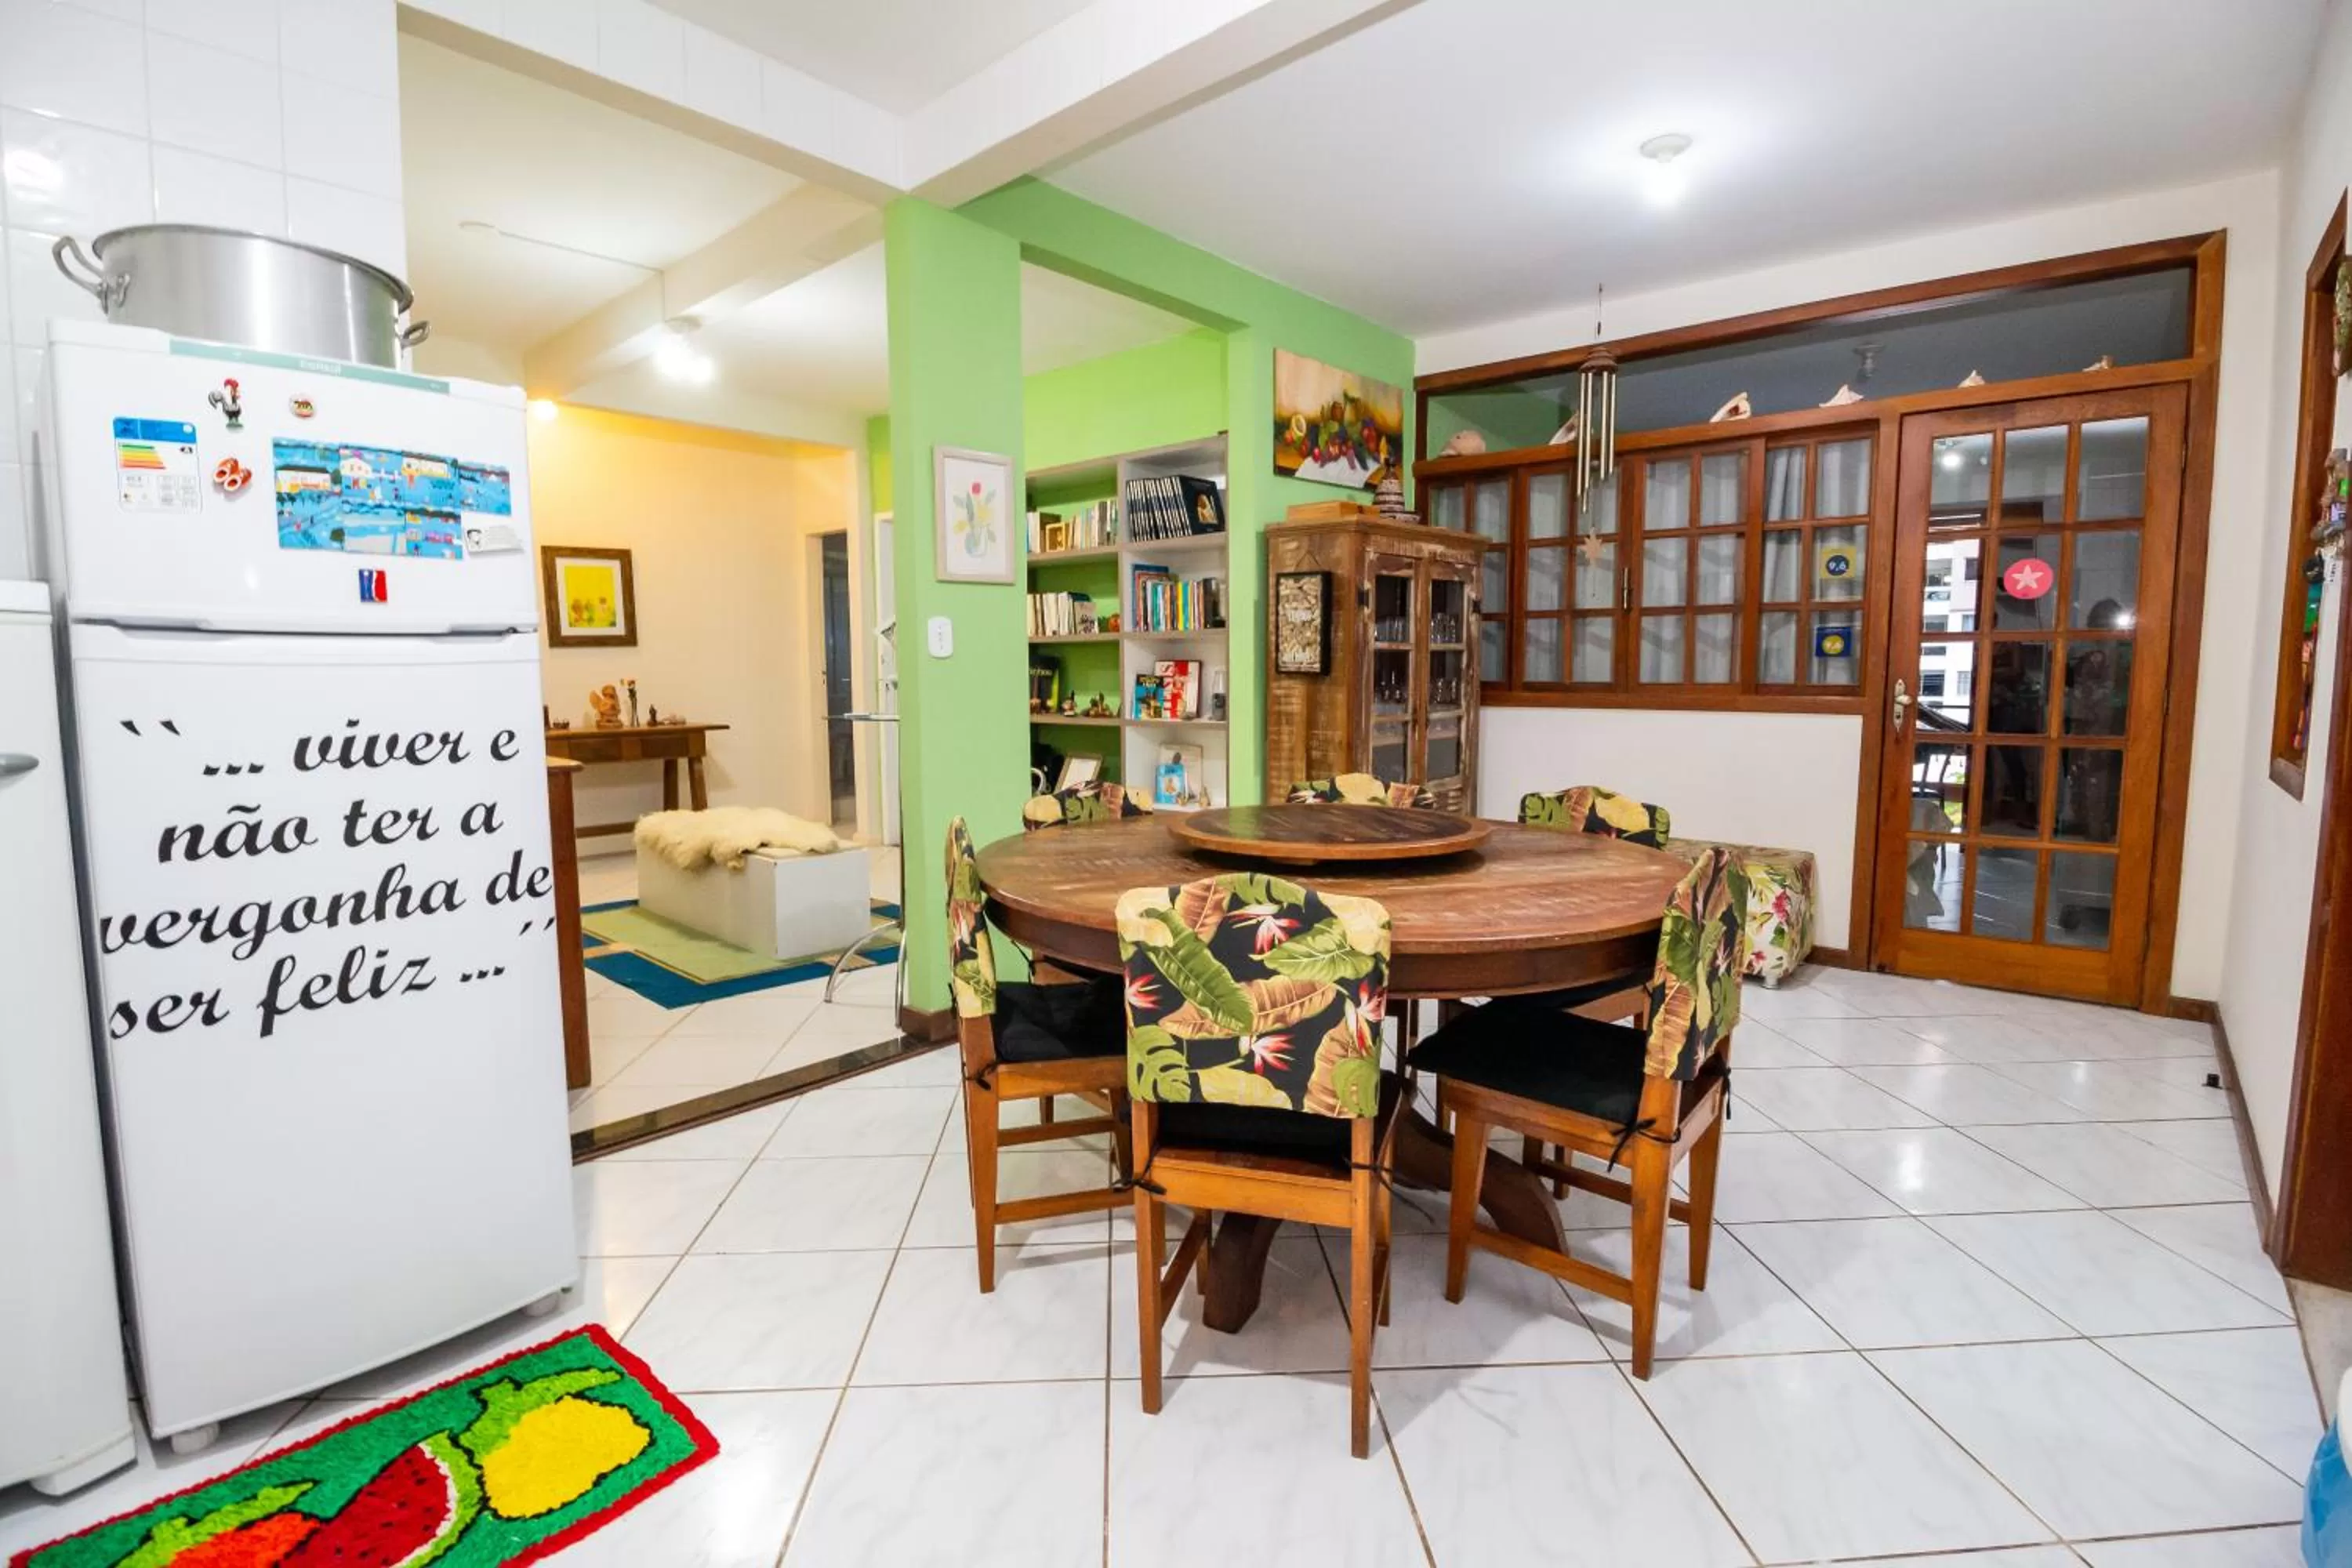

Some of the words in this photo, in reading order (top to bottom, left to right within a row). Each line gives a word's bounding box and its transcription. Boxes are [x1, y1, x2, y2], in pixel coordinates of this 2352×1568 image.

[293, 719, 470, 771] viver
[489, 729, 519, 761] e
[158, 804, 319, 863] não
[343, 799, 440, 848] ter
[460, 801, 504, 837] a
[100, 863, 466, 960] vergonha
[485, 848, 553, 906] de
[110, 989, 230, 1040] ser
[256, 945, 437, 1039] feliz
